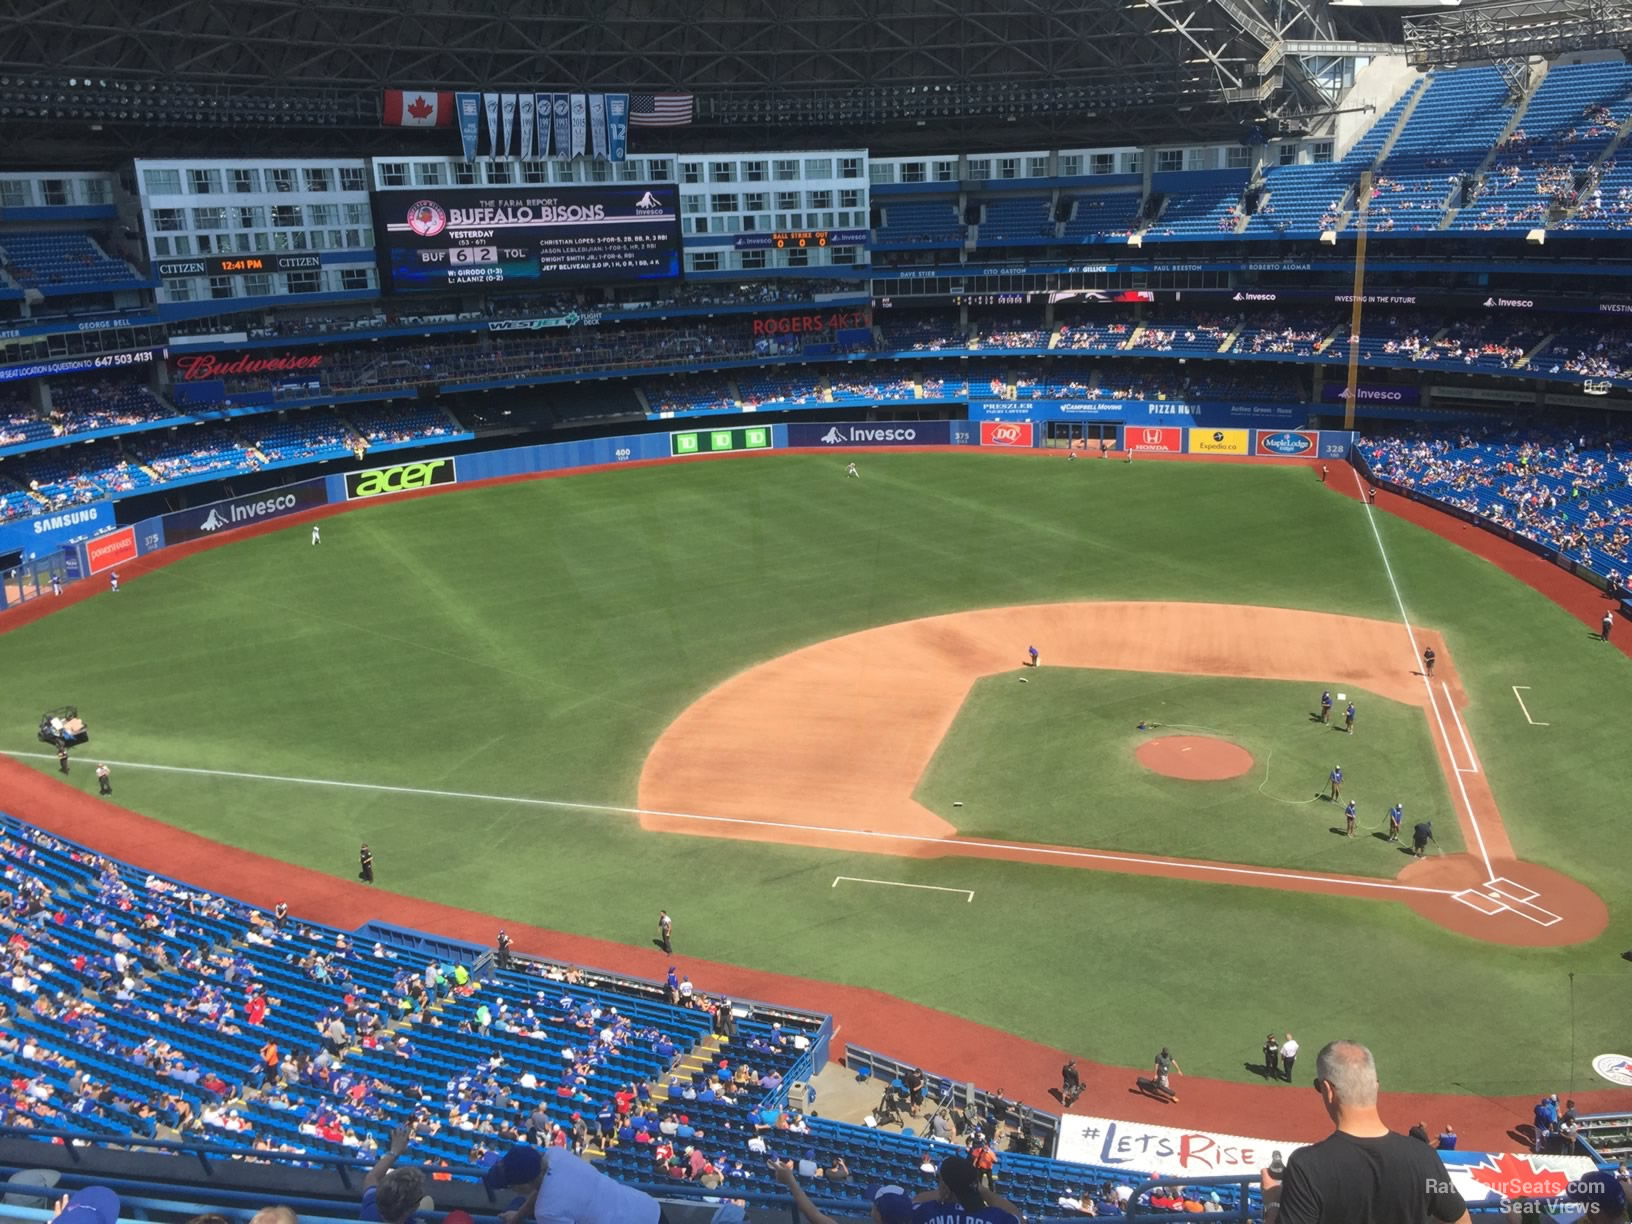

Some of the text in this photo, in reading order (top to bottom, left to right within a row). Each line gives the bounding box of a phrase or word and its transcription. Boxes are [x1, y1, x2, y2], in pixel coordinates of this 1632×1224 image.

[610, 124, 626, 140] 12
[526, 198, 558, 206] REPORT
[448, 205, 604, 225] BUFFALO BISONS
[449, 230, 494, 239] YESTERDAY
[422, 248, 526, 262] BUF 6 2 TOL
[221, 260, 262, 270] 12:41 PM
[279, 257, 320, 267] CITIZEN
[160, 263, 204, 274] CITIZEN
[1498, 298, 1533, 307] Invesco
[78, 321, 110, 330] GEORGE
[753, 316, 824, 336] ROGERS
[829, 314, 849, 329] 4K
[5, 370, 19, 379] SEAT
[19, 366, 47, 376] LOCATION
[52, 360, 83, 372] QUESTION
[94, 355, 112, 368] 647
[114, 354, 132, 365] 503
[134, 352, 152, 362] 4131
[177, 352, 323, 380] Budweiser
[1357, 388, 1401, 400] Invesco
[1149, 404, 1201, 414] PIZZA NOVA
[748, 432, 764, 443] TD
[850, 426, 916, 441] Invesco
[997, 429, 1017, 440] DQ
[680, 438, 695, 449] TD
[714, 435, 729, 447] TD
[615, 448, 630, 456] 400
[356, 460, 445, 496] acer
[231, 494, 296, 522] Invesco
[34, 508, 97, 534] SAMSUNG
[145, 534, 159, 546] 375
